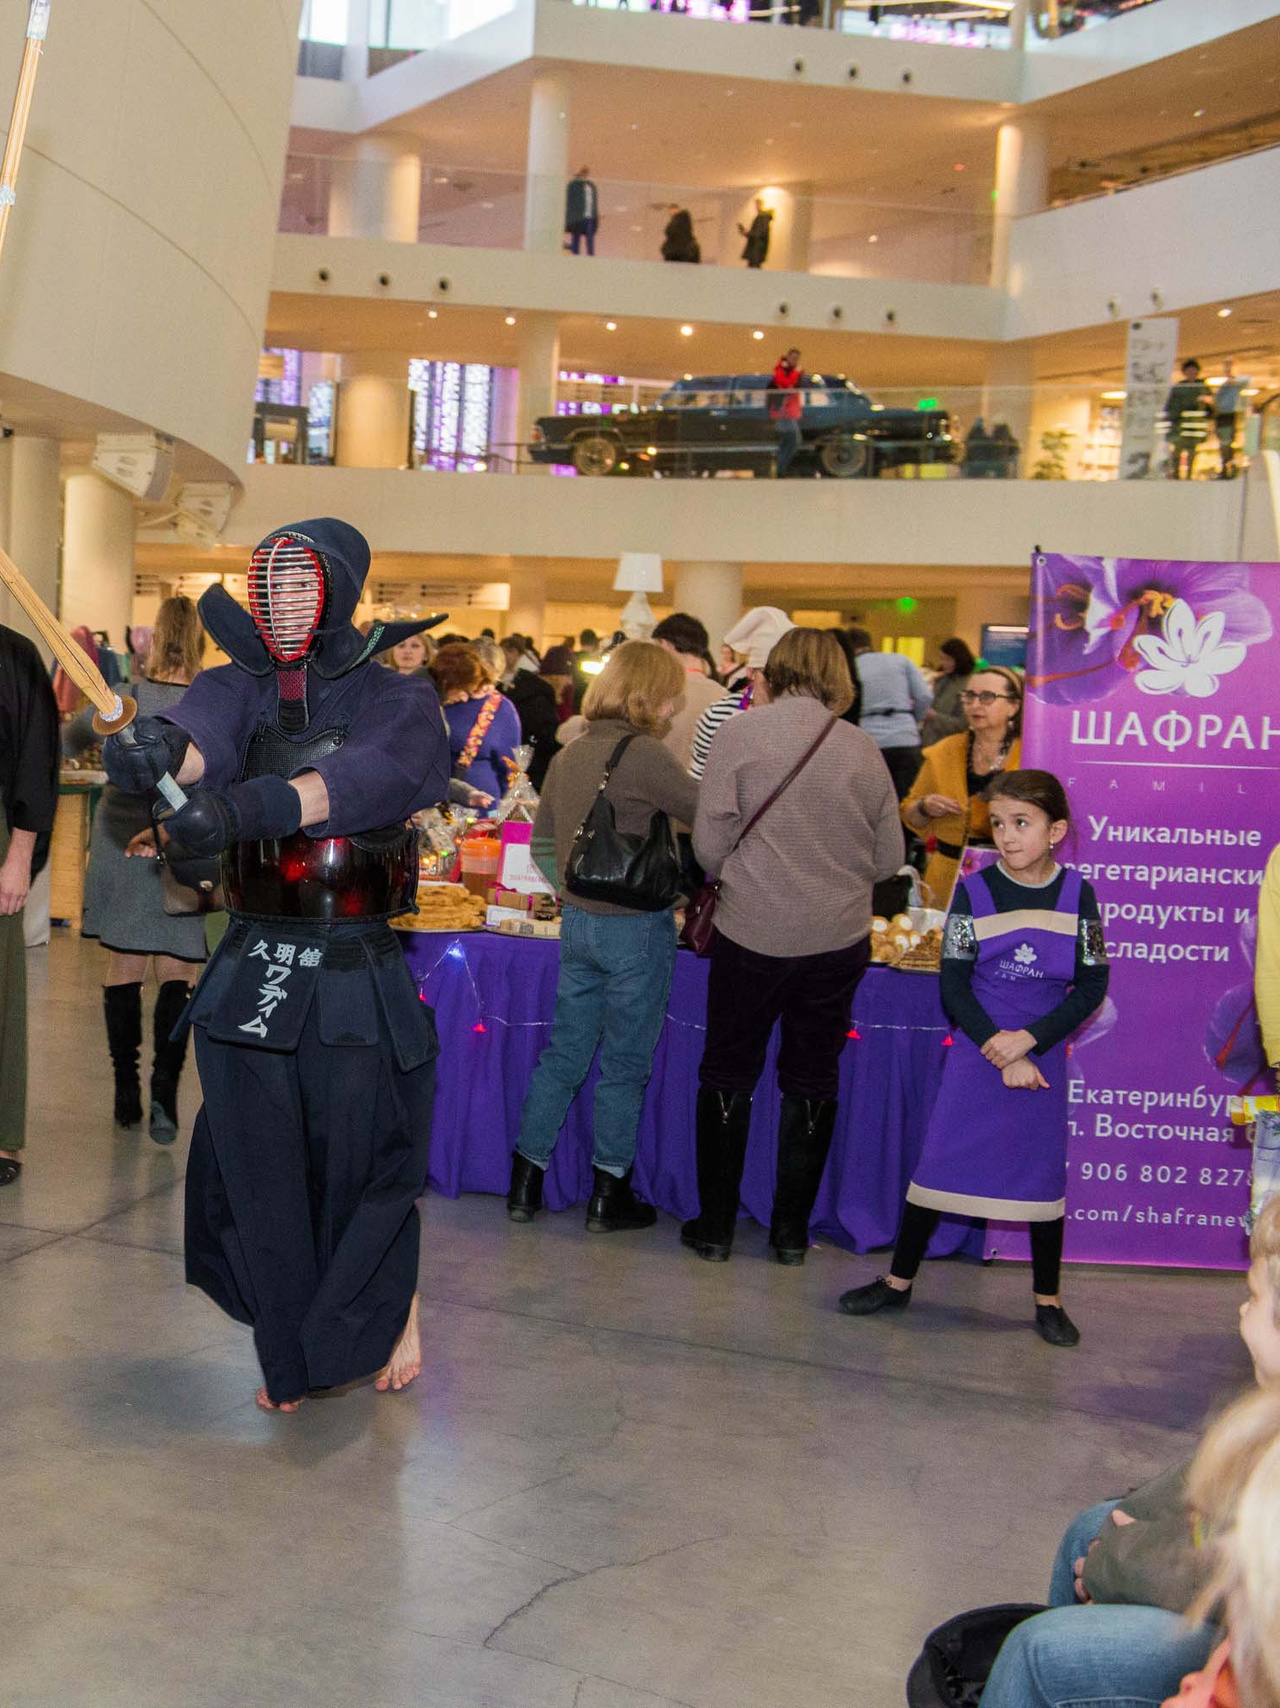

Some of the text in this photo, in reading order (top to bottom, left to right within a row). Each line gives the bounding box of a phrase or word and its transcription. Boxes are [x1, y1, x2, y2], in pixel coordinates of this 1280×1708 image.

[1088, 815, 1262, 846] Уникальные
[1235, 908, 1249, 924] и
[1106, 942, 1229, 963] сладости
[999, 959, 1044, 979] ШАФРАН
[238, 964, 292, 1039] ワディム
[1095, 1114, 1235, 1142] Восточная
[1081, 1163, 1128, 1182] 906
[1140, 1165, 1187, 1184] 802
